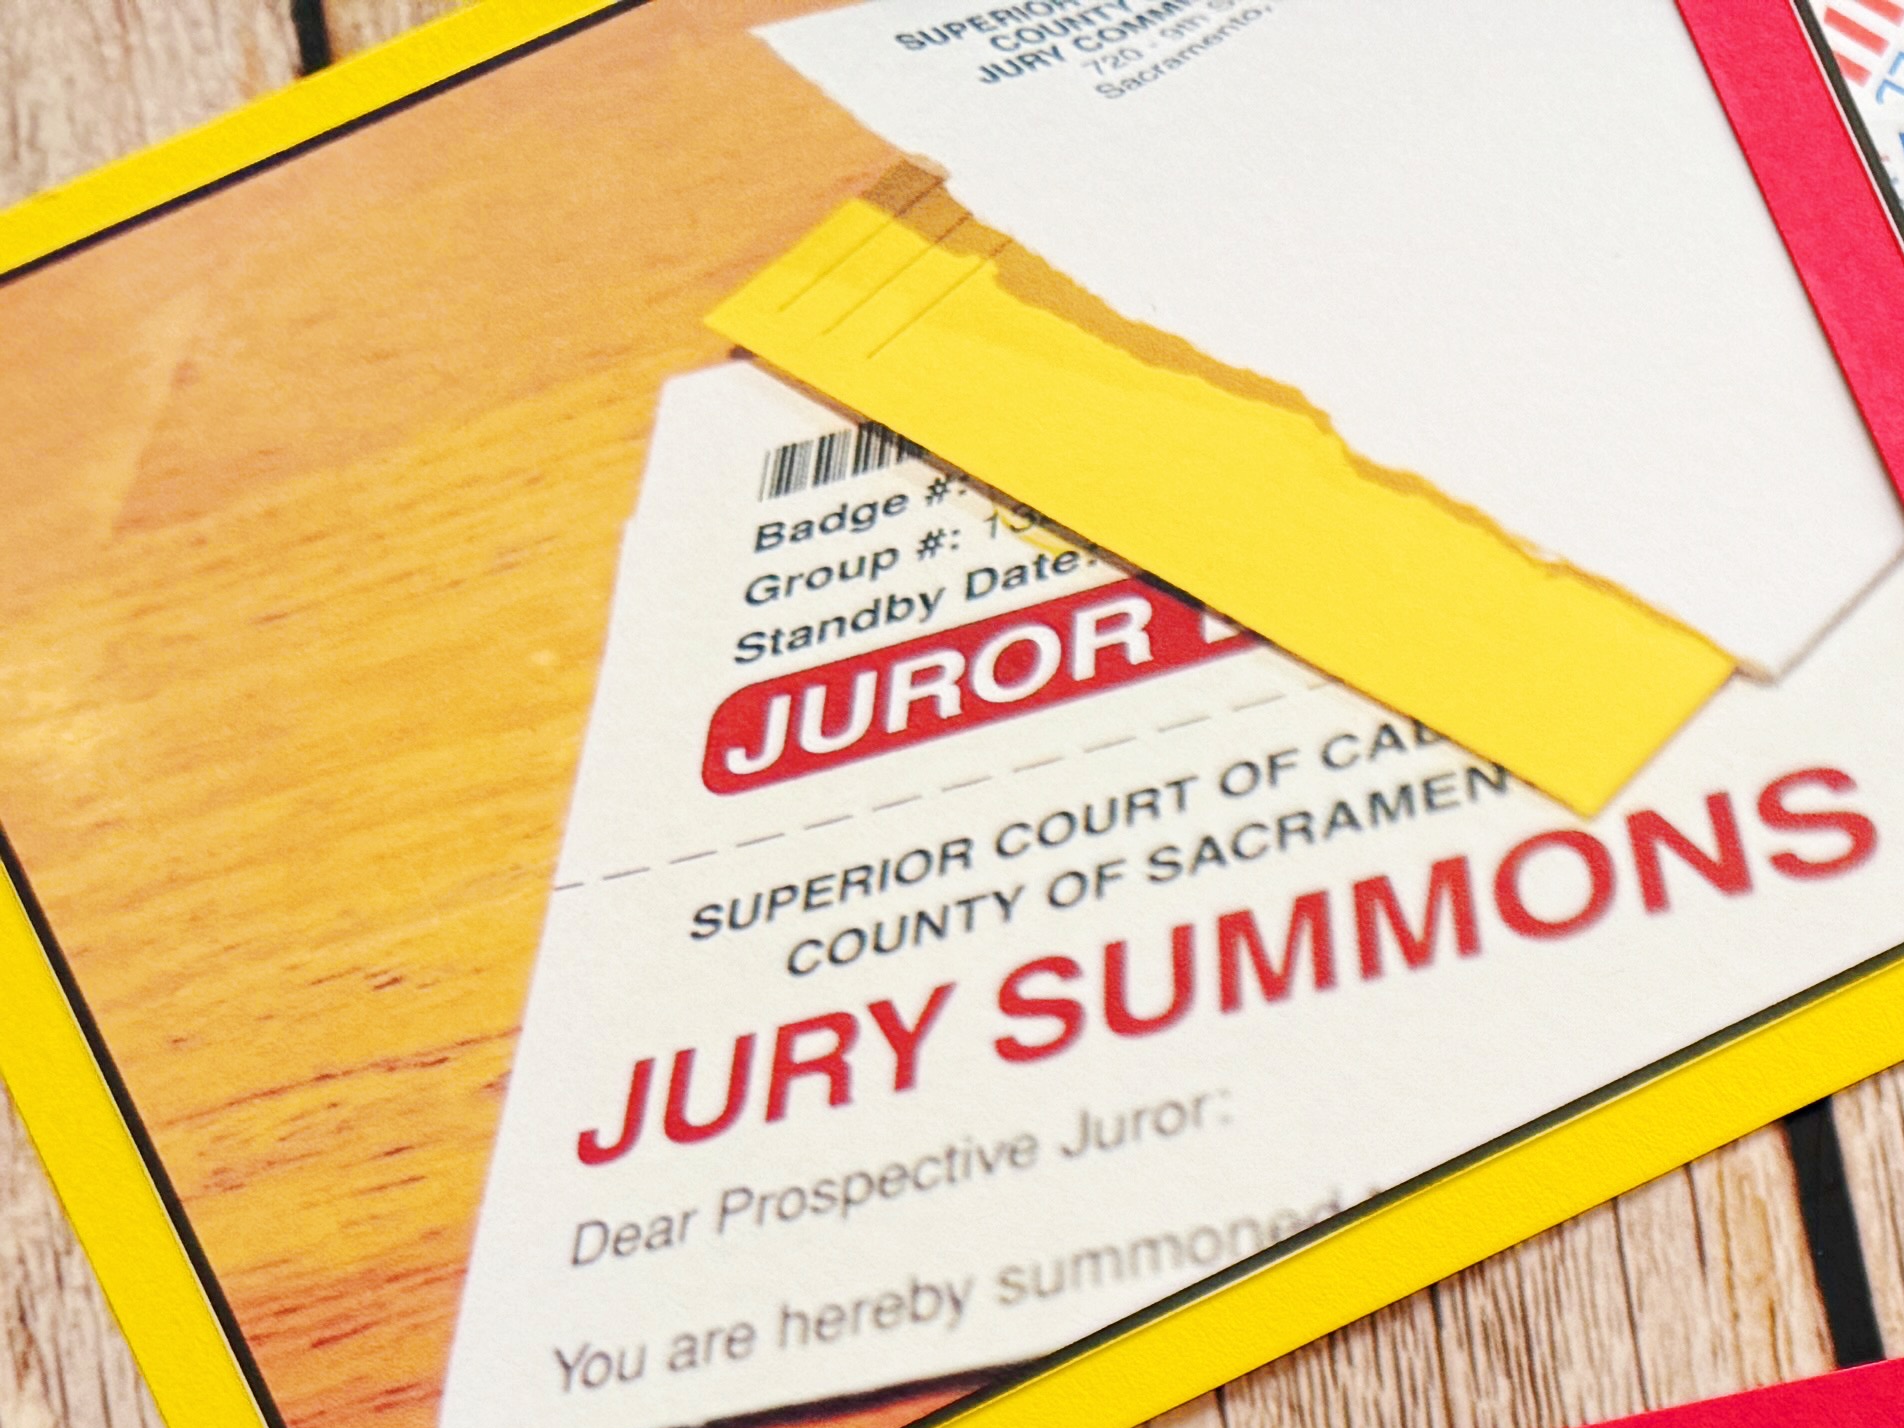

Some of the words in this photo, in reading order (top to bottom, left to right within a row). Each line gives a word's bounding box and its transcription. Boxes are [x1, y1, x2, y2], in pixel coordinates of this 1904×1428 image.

[977, 45, 1064, 84] JURY
[990, 0, 1134, 53] COUNTY
[1081, 47, 1144, 75] 720
[1096, 5, 1272, 100] Sacramento,
[744, 543, 899, 607] Group
[917, 526, 961, 562] #:
[753, 489, 909, 554] Badge
[734, 587, 946, 666] Standby
[724, 595, 1155, 777] JUROR
[689, 835, 975, 941] SUPERIOR
[994, 774, 1199, 860] COURT
[1219, 748, 1298, 799] OF
[1320, 718, 1449, 770] CAL
[786, 883, 1023, 978] COUNTY
[1048, 859, 1126, 910] OF
[1149, 762, 1509, 884] SACRAMEN
[576, 981, 956, 1169] JURY
[991, 765, 1881, 1070] SUMMONS
[571, 1200, 698, 1269] Dear
[714, 1131, 1038, 1238] Prospective
[1059, 1085, 1236, 1159] Juror:
[554, 1342, 647, 1396] You
[666, 1317, 757, 1374] are
[777, 1272, 975, 1351] hereby
